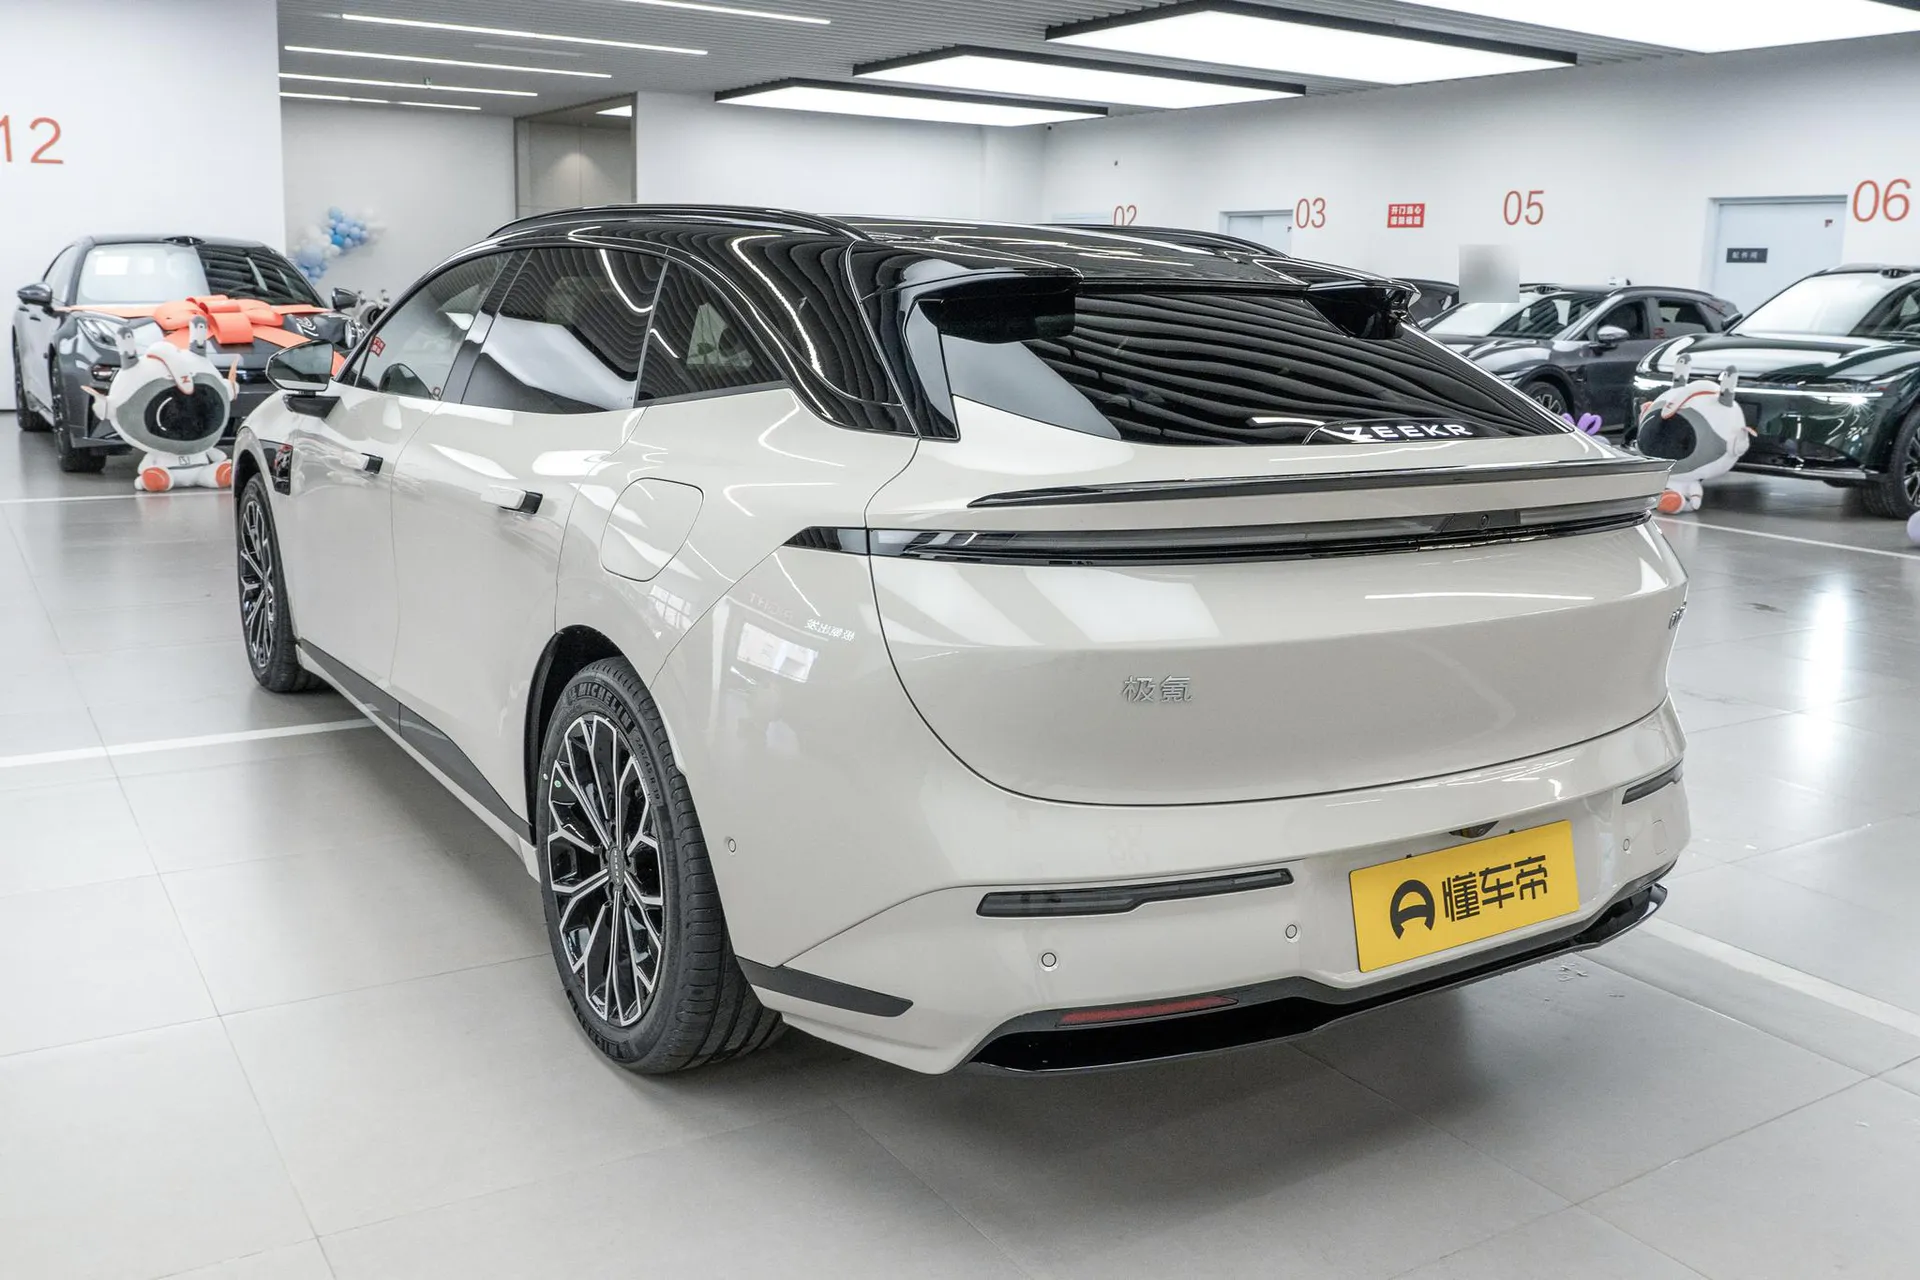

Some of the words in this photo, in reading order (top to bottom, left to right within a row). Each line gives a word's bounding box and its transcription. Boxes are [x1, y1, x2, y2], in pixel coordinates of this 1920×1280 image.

[0, 115, 64, 164] 12
[1114, 205, 1137, 226] 02
[1296, 198, 1326, 229] 03
[1504, 190, 1544, 225] 05
[1853, 178, 1911, 222] 06
[1342, 424, 1473, 440] ZEEKR
[1123, 675, 1192, 702] 极氪
[579, 681, 634, 732] MICHELIN
[1441, 855, 1548, 922] 懂车帝
